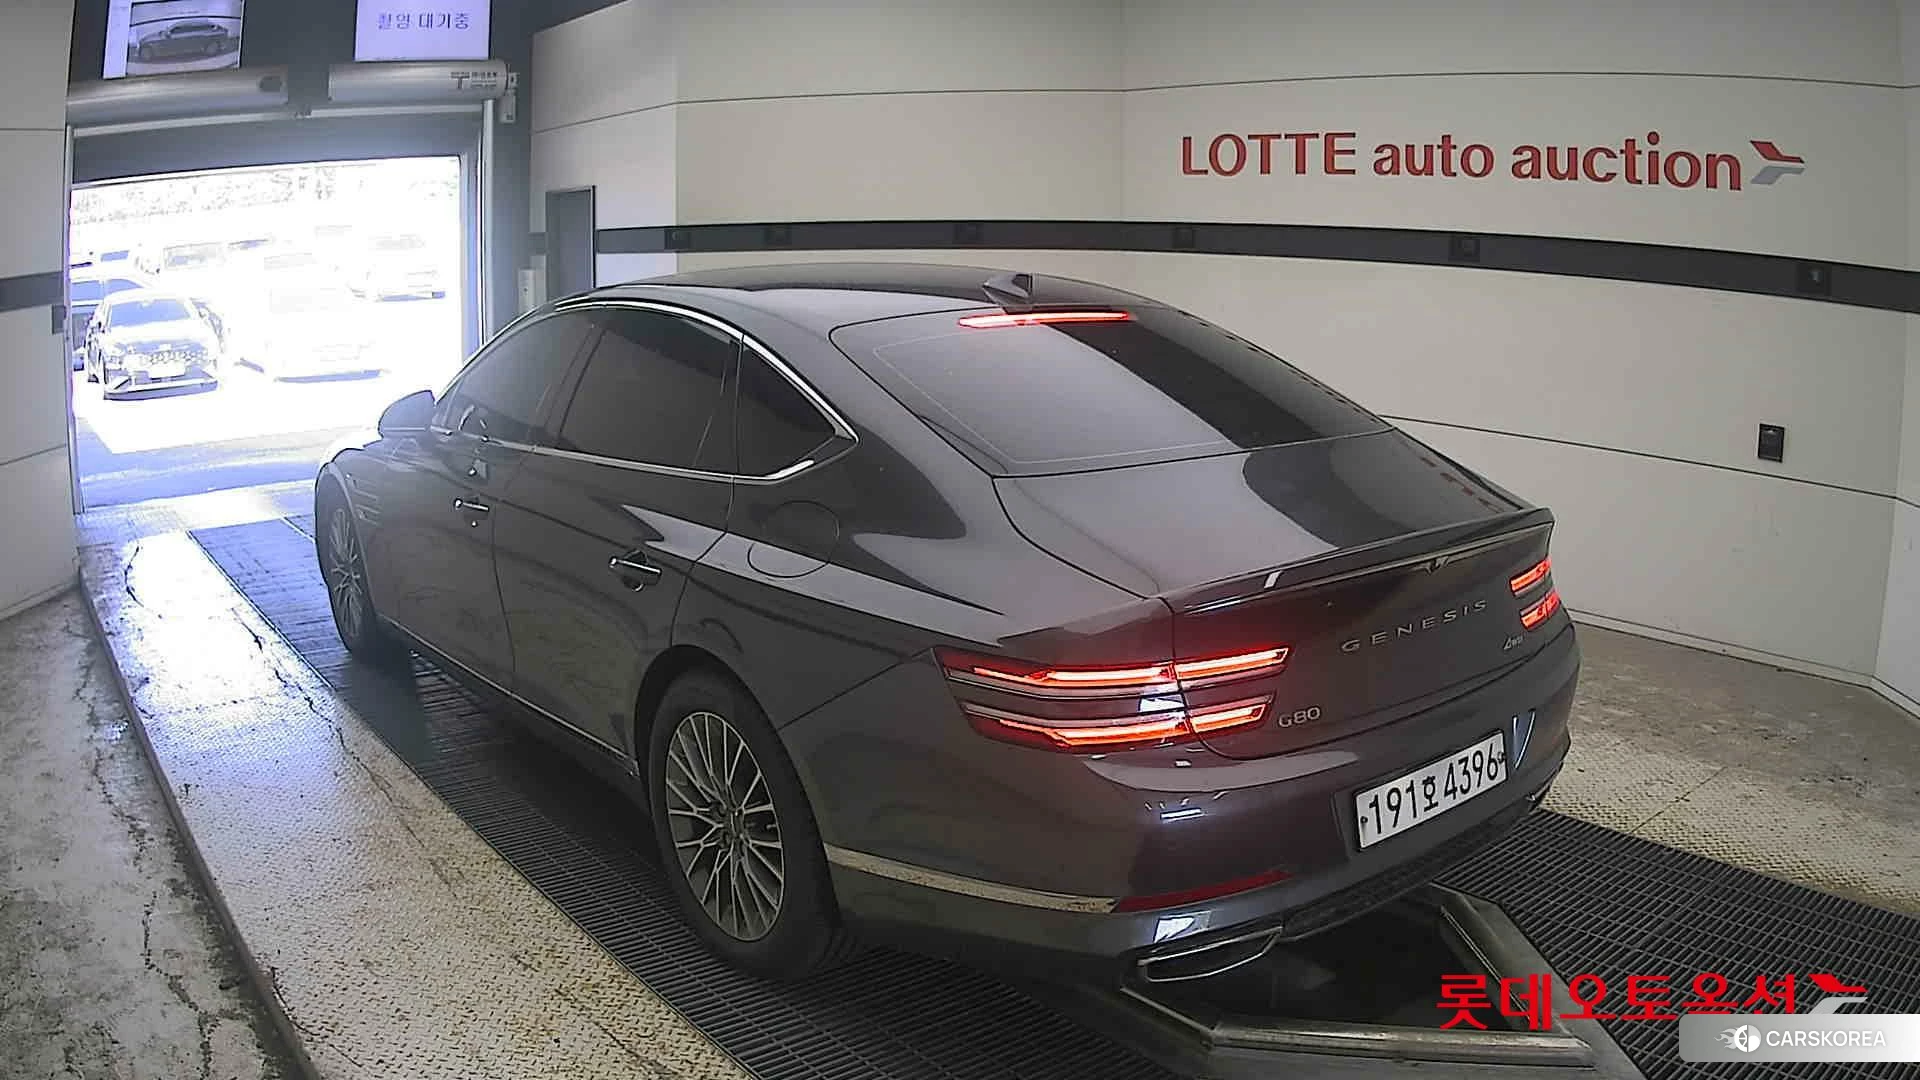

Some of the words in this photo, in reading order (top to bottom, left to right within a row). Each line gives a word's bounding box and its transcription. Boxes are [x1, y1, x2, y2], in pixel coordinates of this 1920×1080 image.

[419, 12, 469, 30] 대기중
[1181, 132, 1357, 177] LOTTE
[1373, 134, 1495, 177] auto
[1511, 131, 1742, 191] auction
[1341, 599, 1488, 653] GENESIS
[1278, 706, 1321, 729] G80
[1443, 743, 1499, 801] 4396
